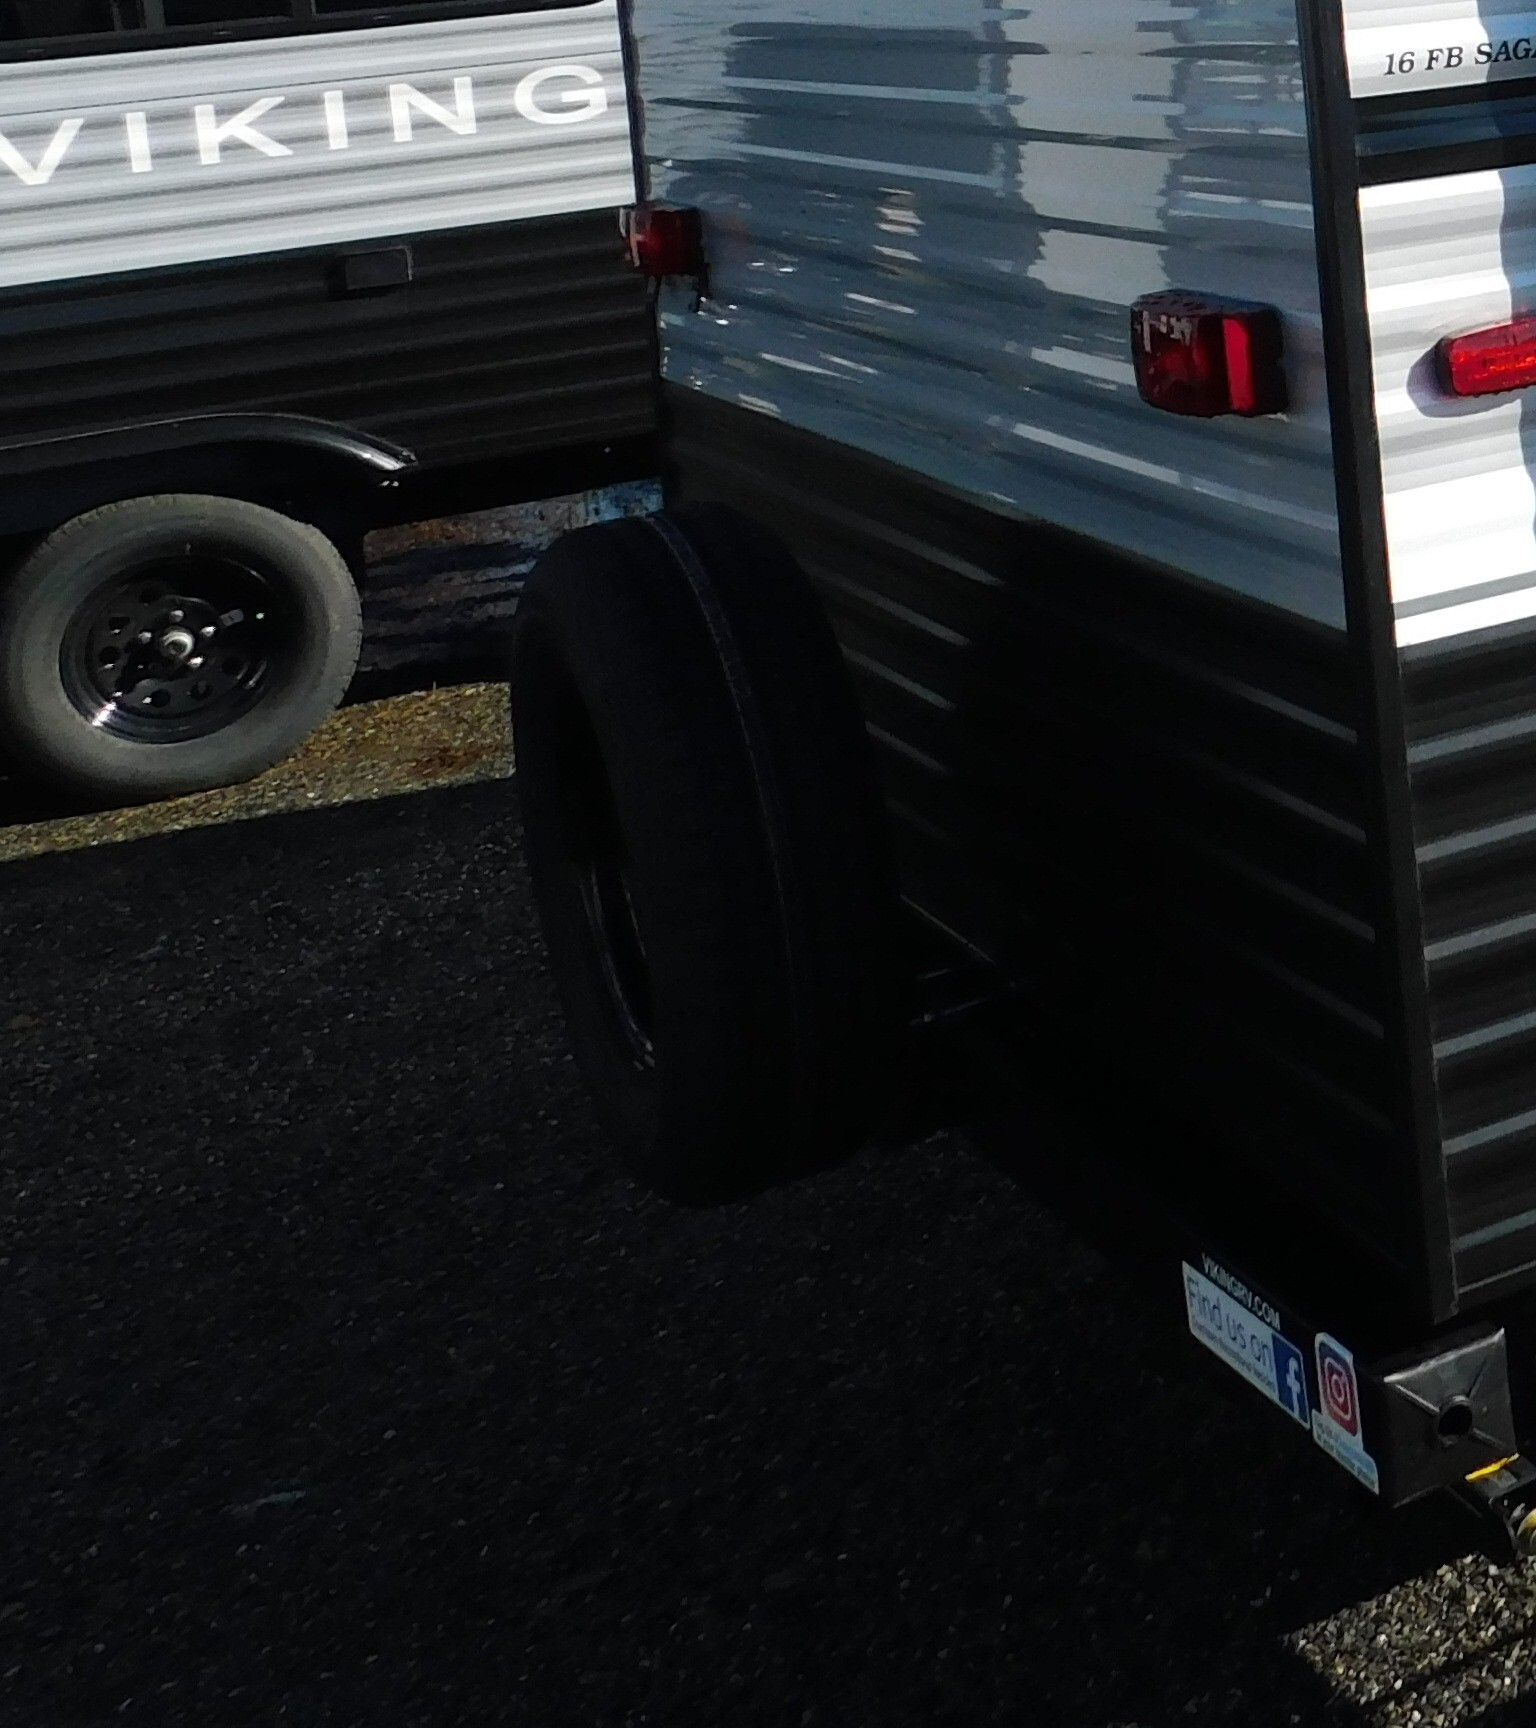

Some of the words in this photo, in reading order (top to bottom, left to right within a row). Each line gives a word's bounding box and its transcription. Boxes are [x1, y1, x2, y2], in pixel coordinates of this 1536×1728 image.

[1384, 51, 1415, 76] 16
[1425, 46, 1464, 71] FB
[0, 64, 608, 186] VIKING
[1187, 1275, 1222, 1331] Find
[1226, 1314, 1246, 1350] us
[1250, 1334, 1271, 1367] on
